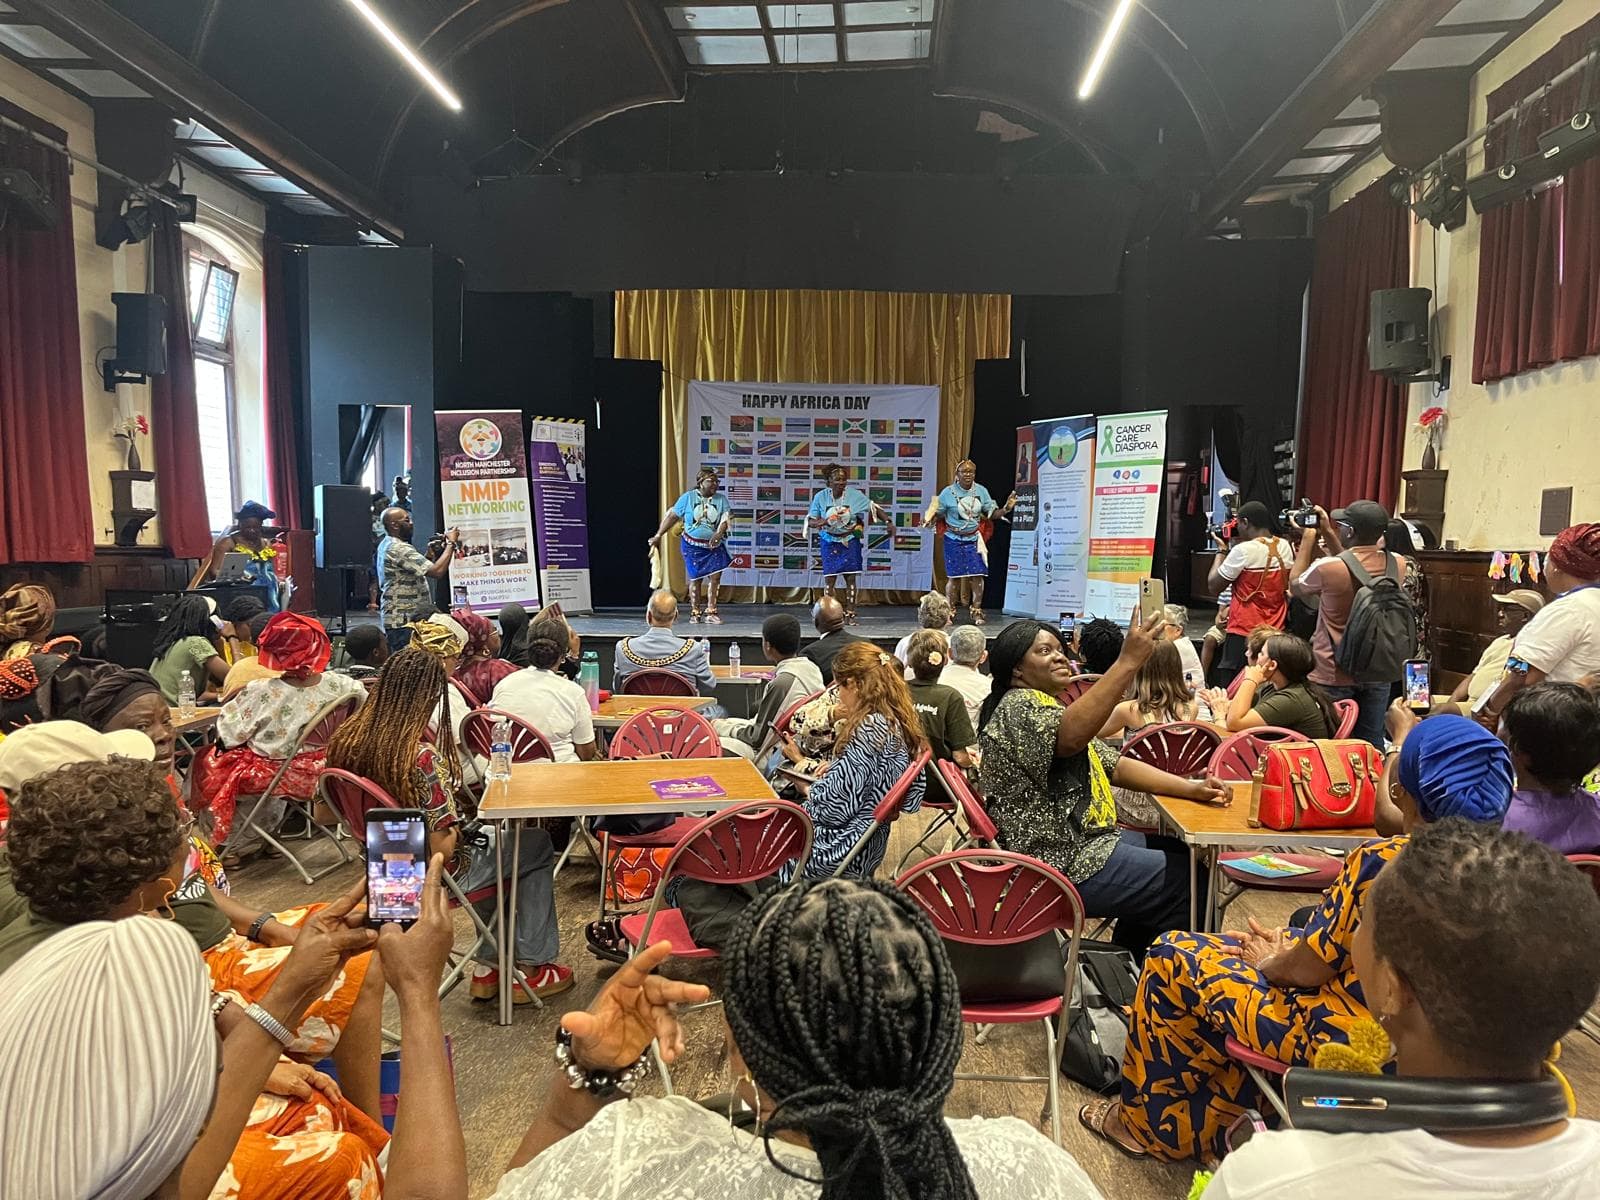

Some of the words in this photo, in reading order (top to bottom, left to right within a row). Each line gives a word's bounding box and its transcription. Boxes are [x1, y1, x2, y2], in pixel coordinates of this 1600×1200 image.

[742, 394, 787, 408] HAPPY
[790, 395, 841, 410] AFRICA
[844, 396, 871, 410] DAY
[1116, 424, 1152, 435] CANCER
[1115, 434, 1139, 443] CARE
[1115, 441, 1158, 452] DIASPORA
[455, 461, 474, 469] NORTH
[475, 460, 511, 468] MANCHESTER
[460, 481, 511, 502] NMIP
[448, 501, 525, 516] NETWORKING
